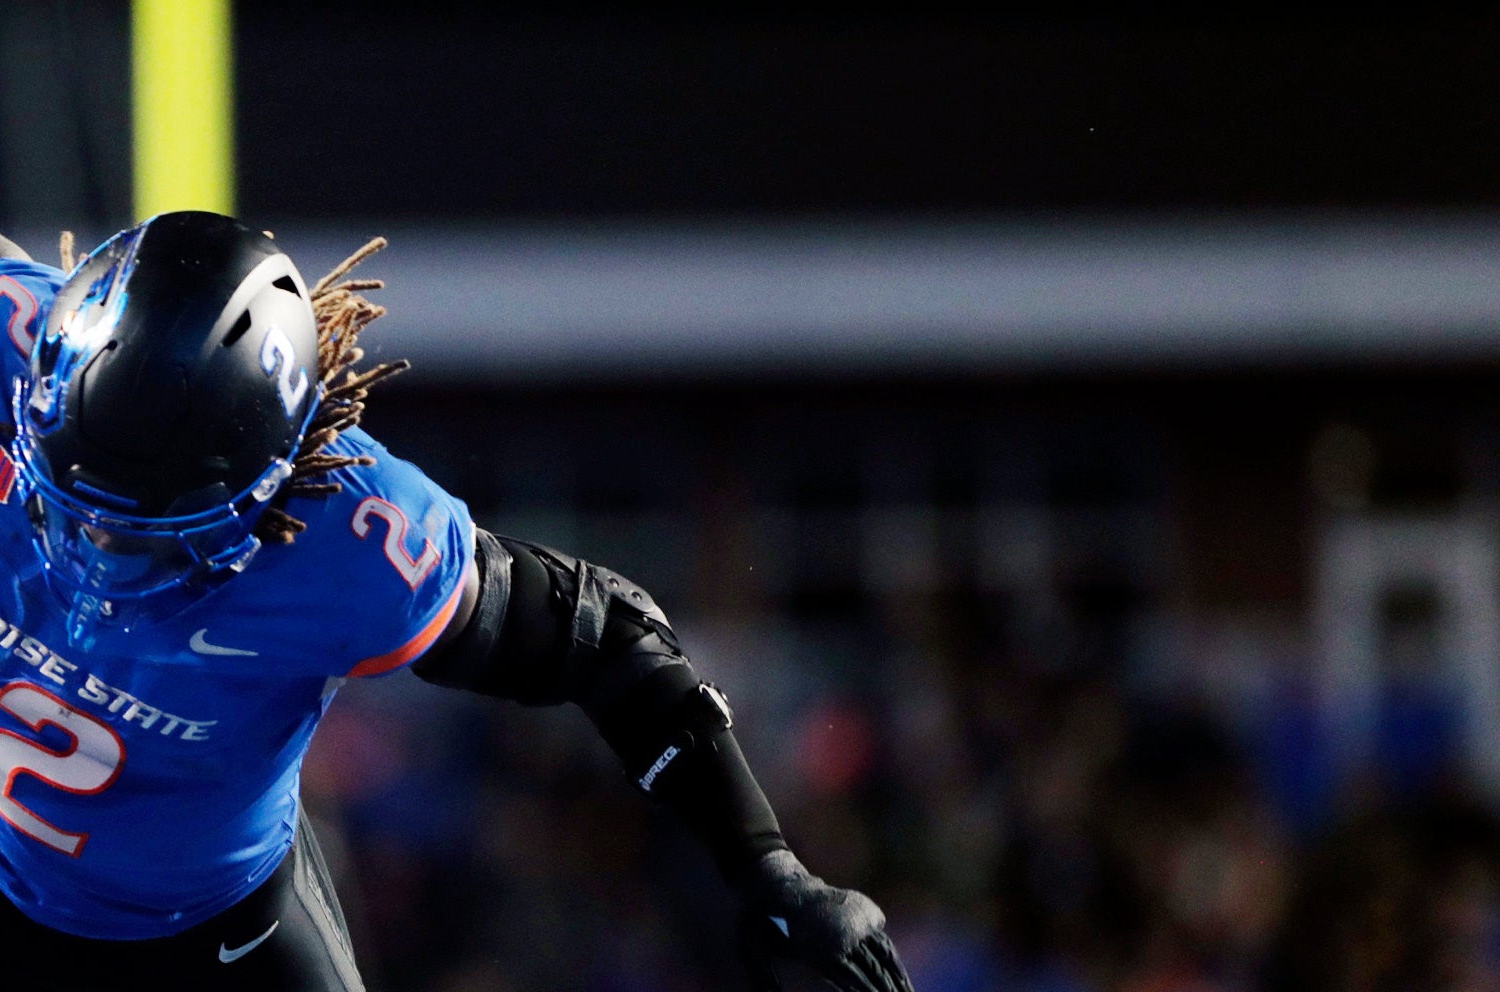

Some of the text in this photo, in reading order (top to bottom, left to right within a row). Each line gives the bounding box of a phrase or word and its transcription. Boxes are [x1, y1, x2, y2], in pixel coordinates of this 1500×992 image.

[260, 326, 309, 419] 2
[349, 495, 442, 592] 2
[78, 674, 218, 741] STATE
[643, 745, 679, 785] BREG
